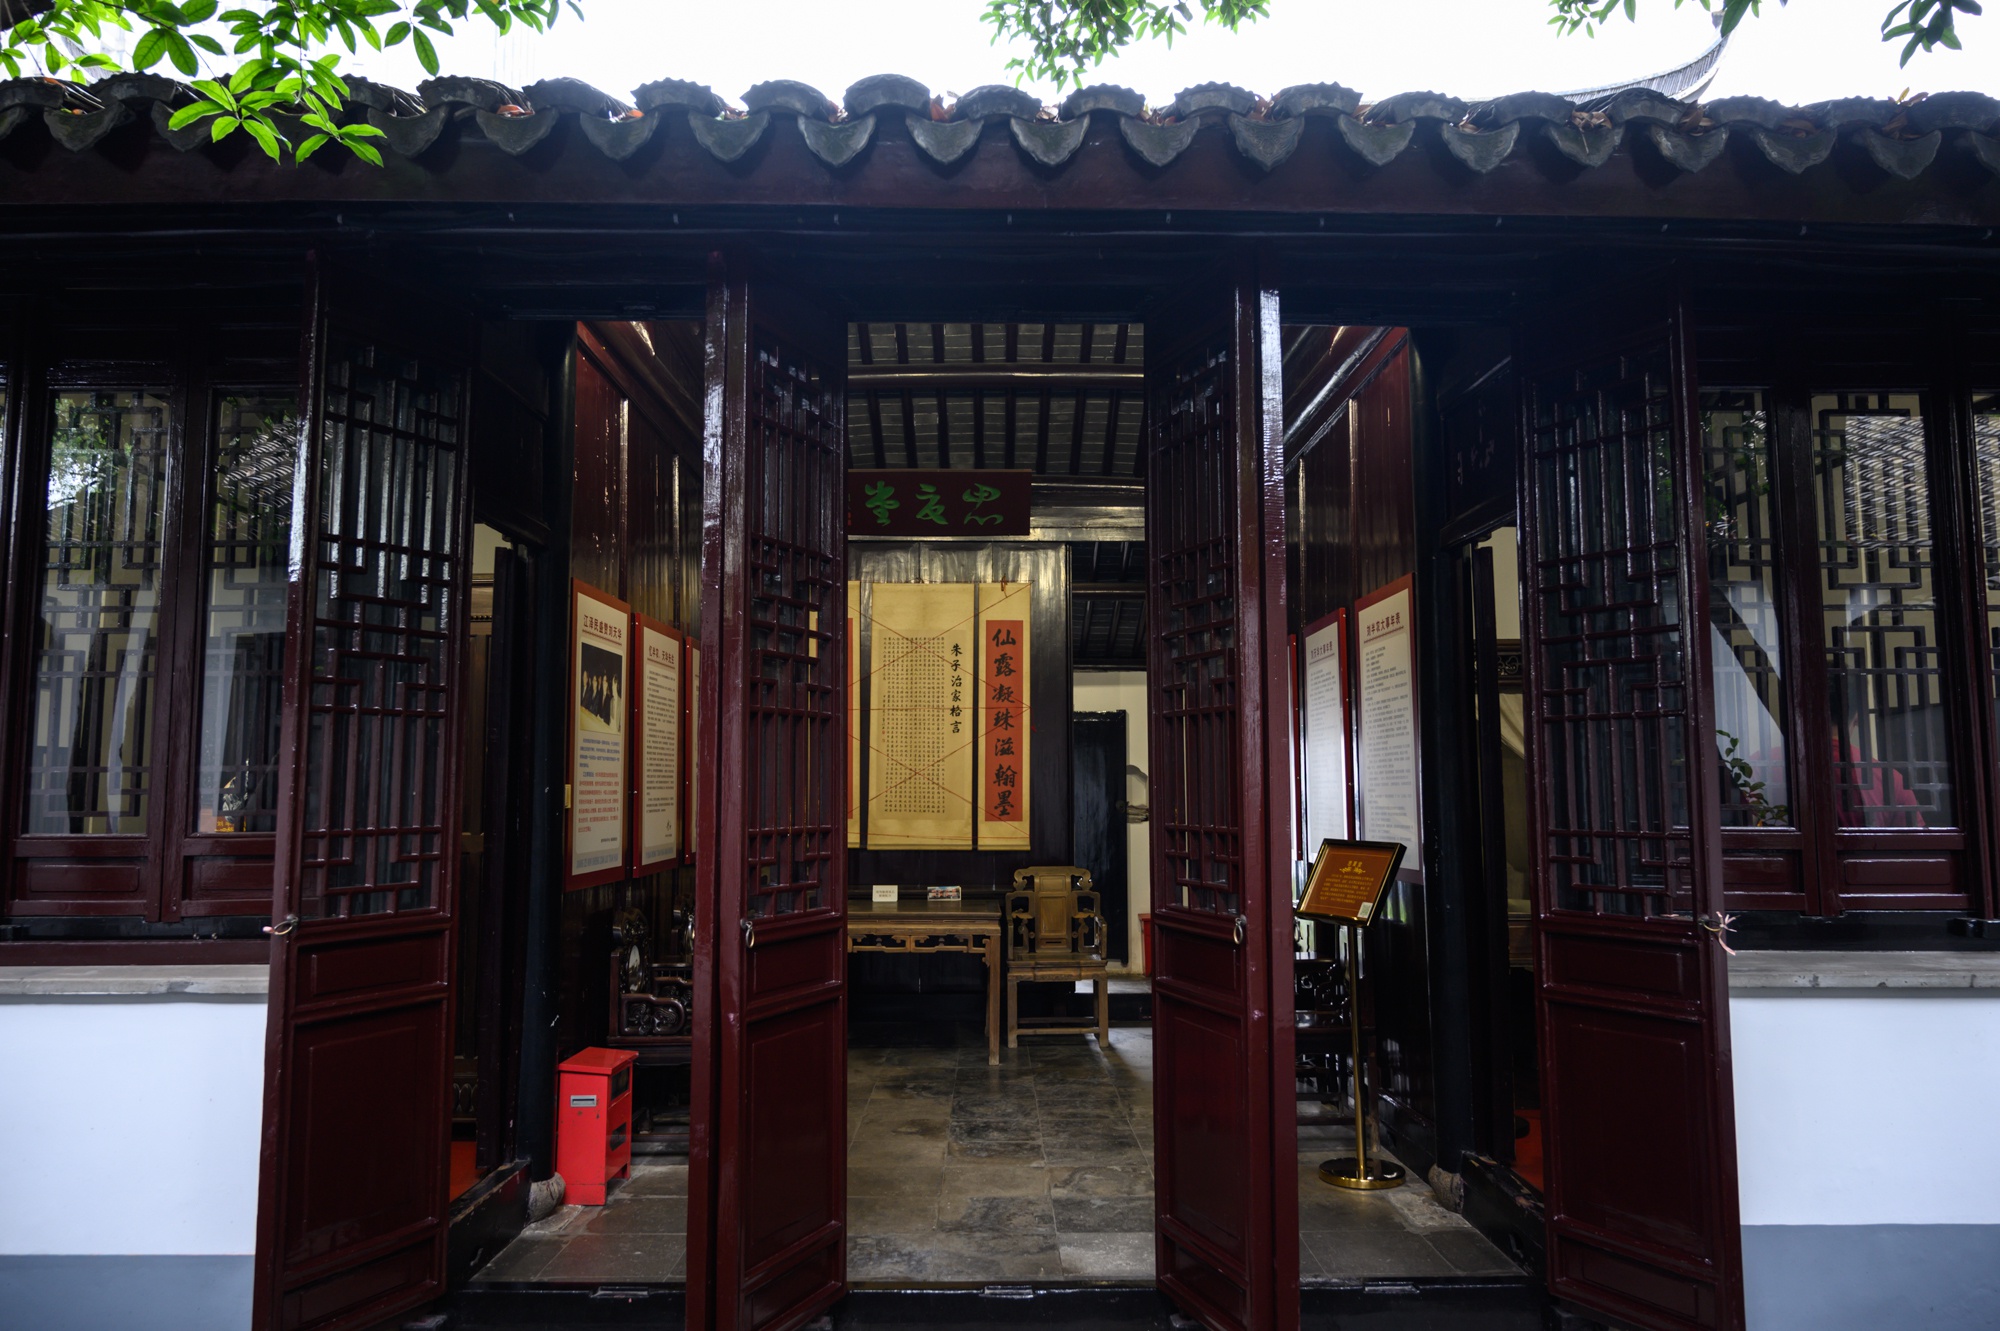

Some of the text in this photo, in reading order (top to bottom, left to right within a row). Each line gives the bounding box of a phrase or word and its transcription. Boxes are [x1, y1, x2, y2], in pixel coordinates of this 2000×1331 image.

[864, 480, 1004, 526] 思夏堂
[583, 614, 622, 640] 江泽民盛赞刘天华
[1366, 611, 1401, 637] 刘半农大事年表
[949, 643, 963, 734] 朱子治家格言
[991, 628, 1018, 817] 仙露凝珠滋翰墨
